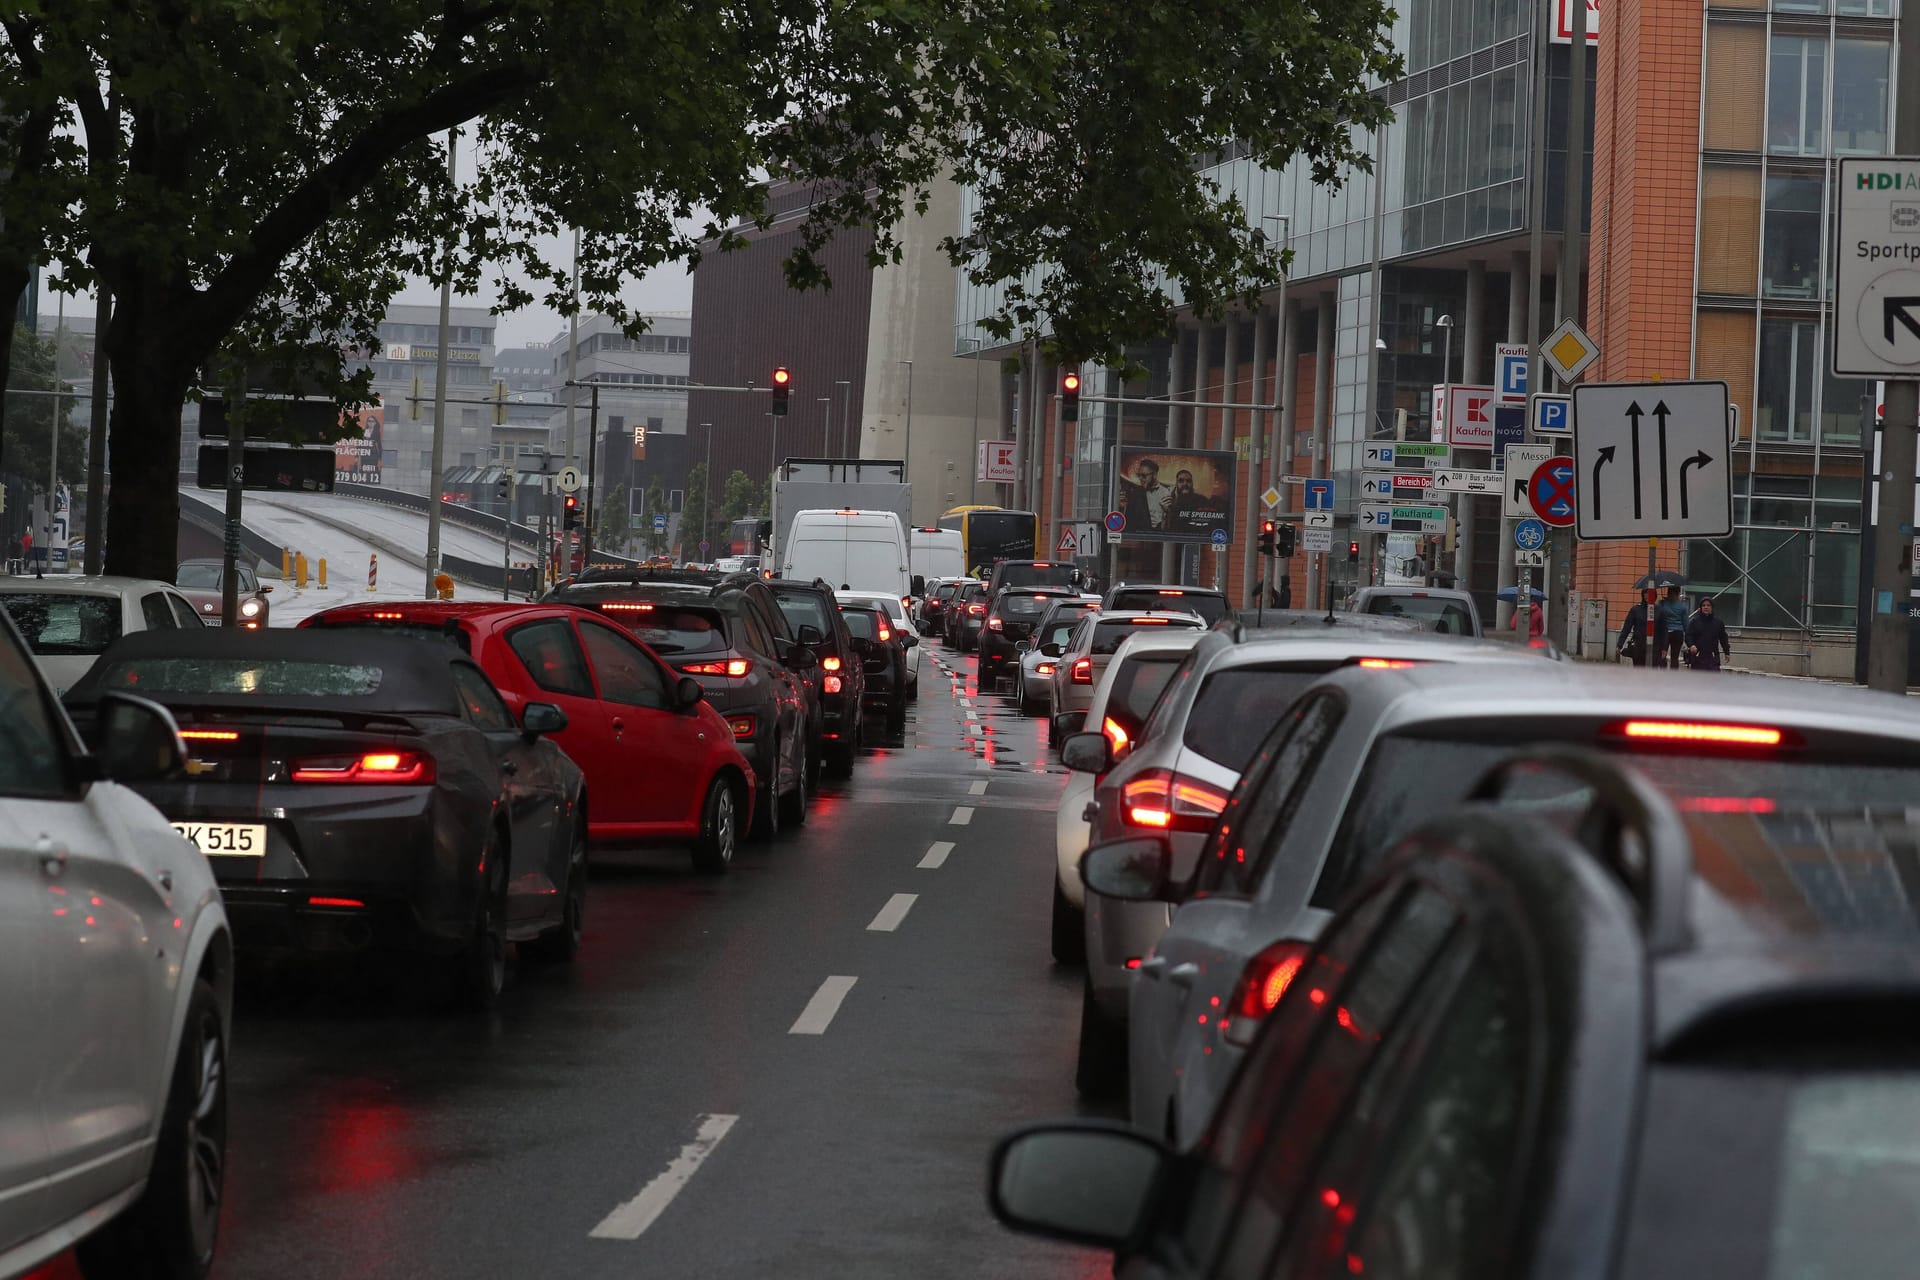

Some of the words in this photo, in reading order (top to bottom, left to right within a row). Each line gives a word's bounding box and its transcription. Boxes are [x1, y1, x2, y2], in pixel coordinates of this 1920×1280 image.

[1857, 172, 1901, 190] HDI
[1510, 362, 1528, 389] P
[1546, 405, 1560, 424] P
[1397, 446, 1421, 455] Bereich
[1521, 451, 1549, 461] Messe
[1397, 476, 1421, 485] Bereich
[1469, 473, 1481, 481] Bus
[1482, 474, 1503, 482] station
[1393, 507, 1432, 518] Kaufland
[208, 827, 253, 850] 515
